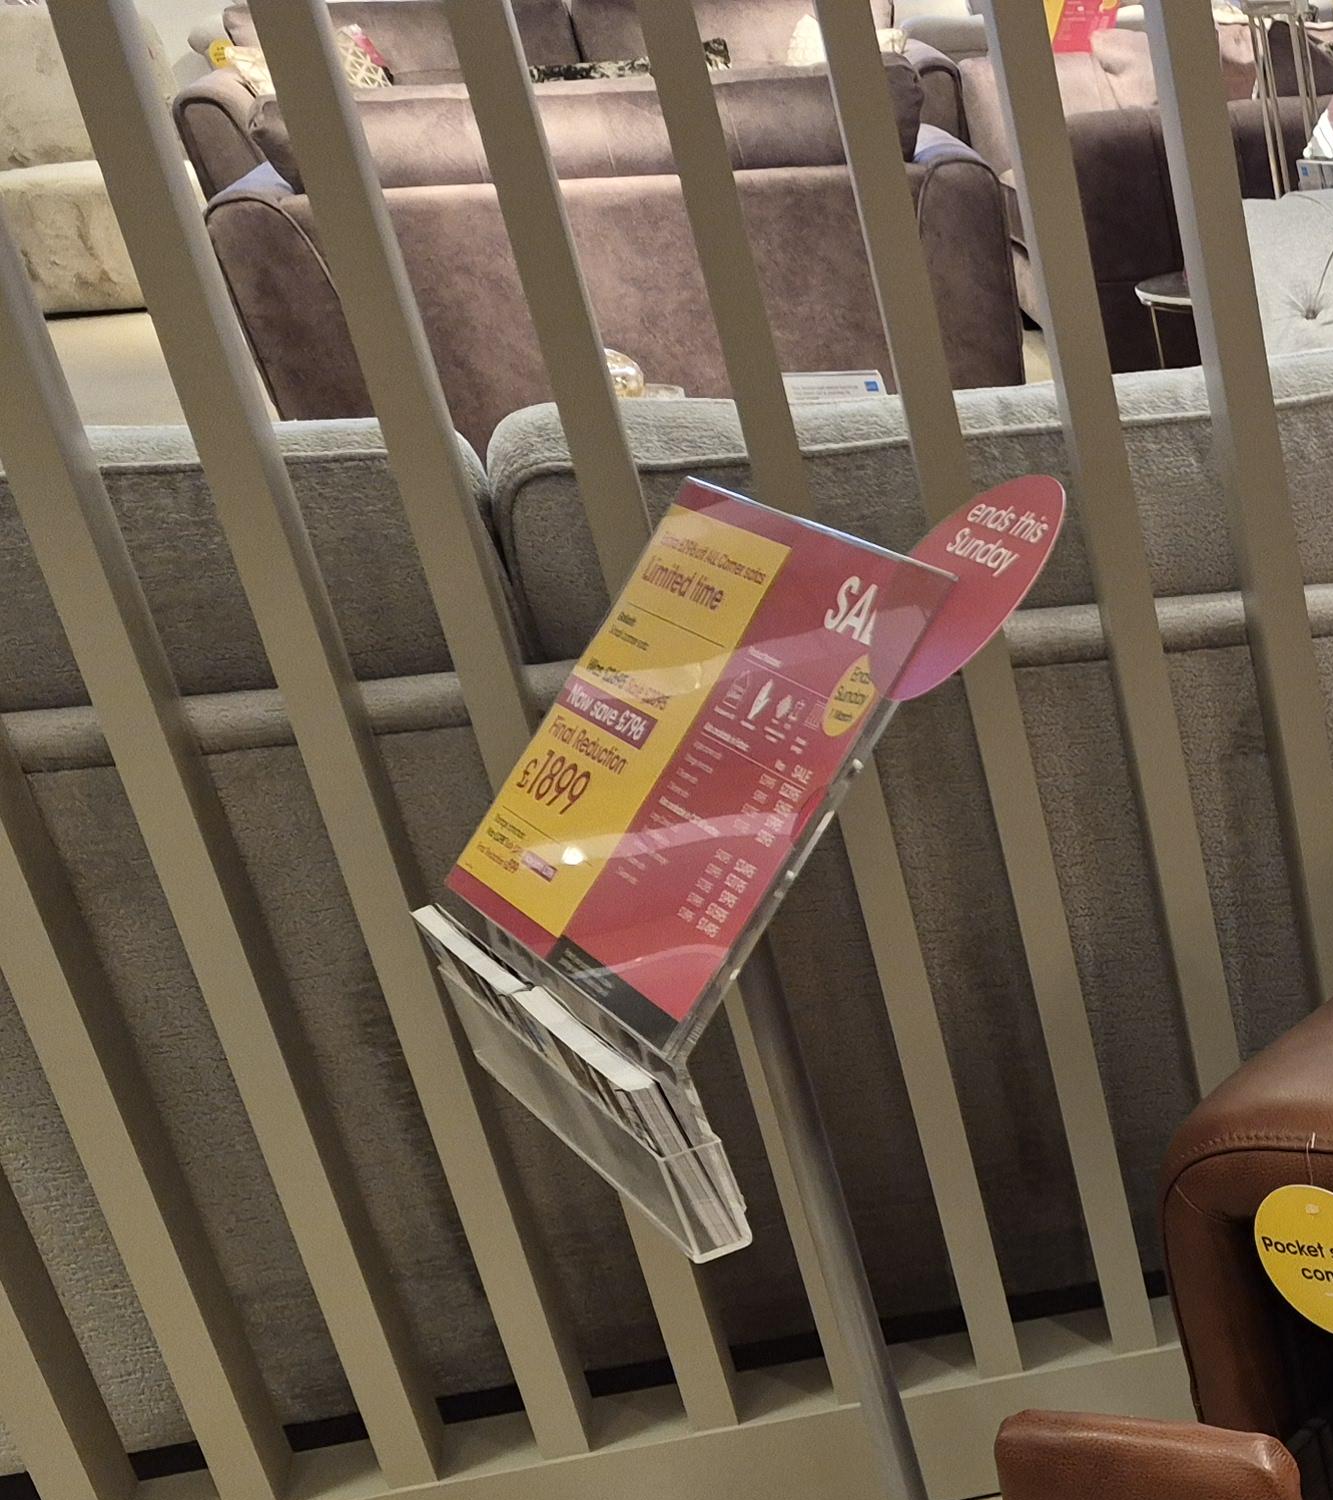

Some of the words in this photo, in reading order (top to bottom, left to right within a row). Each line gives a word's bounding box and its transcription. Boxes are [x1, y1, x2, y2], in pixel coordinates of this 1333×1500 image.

[966, 503, 1014, 532] ends
[1009, 510, 1048, 544] this
[946, 528, 1020, 578] Sunday
[642, 555, 698, 599] Limited
[691, 573, 726, 611] time
[824, 575, 878, 647] SA
[566, 684, 594, 711] Now
[589, 699, 618, 727] save
[615, 709, 647, 741] £796
[549, 714, 574, 746] Final
[574, 728, 629, 776] Reduction
[516, 749, 592, 816] £1899
[1261, 1236, 1326, 1259] Pocket
